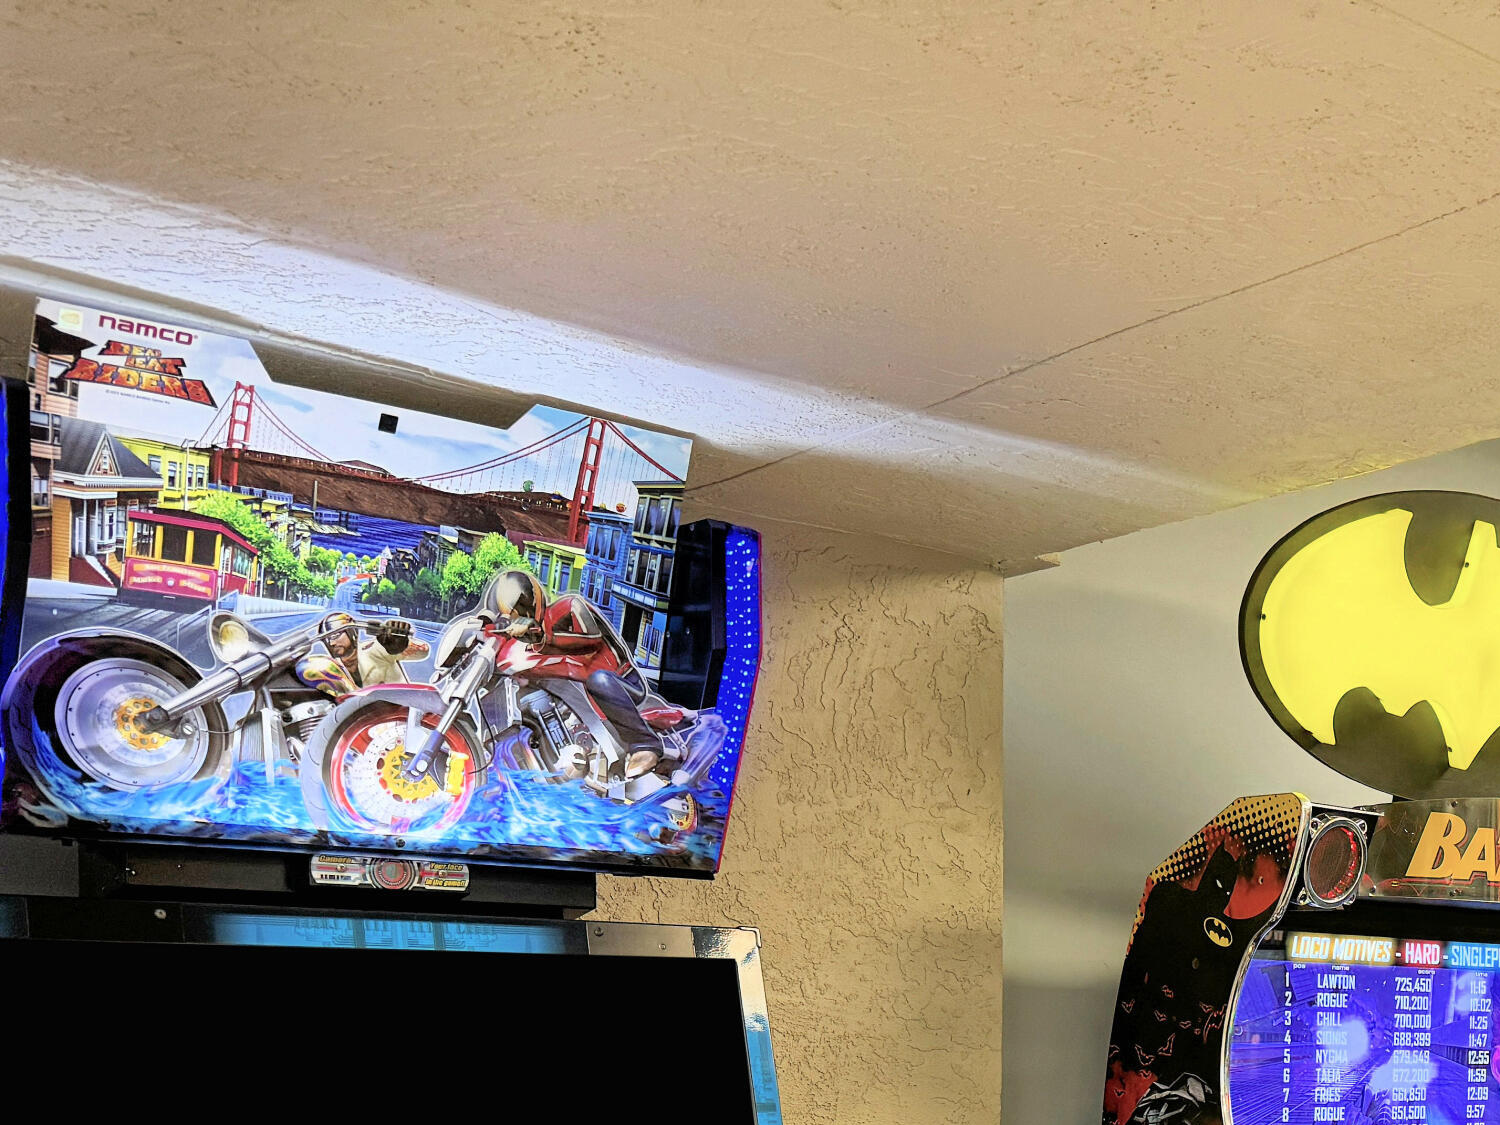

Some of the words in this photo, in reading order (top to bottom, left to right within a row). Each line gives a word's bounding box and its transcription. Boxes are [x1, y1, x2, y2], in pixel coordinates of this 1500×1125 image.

[99, 315, 193, 345] namco
[64, 357, 218, 408] RIDERS
[1291, 936, 1331, 959] LOCO
[1332, 938, 1393, 962] MOTIVES
[1405, 942, 1441, 965] HARD
[1285, 971, 1290, 988] 1
[1317, 973, 1356, 990] LAWTON
[1395, 977, 1432, 993] 725,450
[1470, 980, 1487, 994] 11:15
[1284, 991, 1292, 1007] 2
[1316, 992, 1348, 1008] ROGUE
[1394, 995, 1429, 1011] 710,200
[1469, 998, 1492, 1013] 10:02
[1284, 1010, 1292, 1026] 3
[1316, 1011, 1342, 1027] CHILL
[1393, 1013, 1431, 1029] 700,000
[1469, 1015, 1488, 1030] 11:25
[1284, 1029, 1292, 1045] 4
[1315, 1030, 1348, 1045] SIONIS
[1393, 1031, 1431, 1048] 688,399
[1468, 1033, 1488, 1048] 11:47
[1283, 1048, 1291, 1064] 5
[1315, 1049, 1349, 1064] NYGMA
[1467, 1050, 1490, 1065] 12:55
[1283, 1067, 1290, 1083] 6
[1315, 1068, 1342, 1083] TALIA
[1467, 1068, 1487, 1083] 11:59
[1283, 1087, 1290, 1103] 7
[1314, 1087, 1341, 1103] FRIES
[1392, 1087, 1427, 1102] 661,850
[1467, 1086, 1489, 1101] 12:09
[1282, 1107, 1290, 1123] 8
[1314, 1106, 1346, 1122] ROGUE
[1391, 1105, 1426, 1121] 651,500
[1466, 1104, 1486, 1119] 9:57
